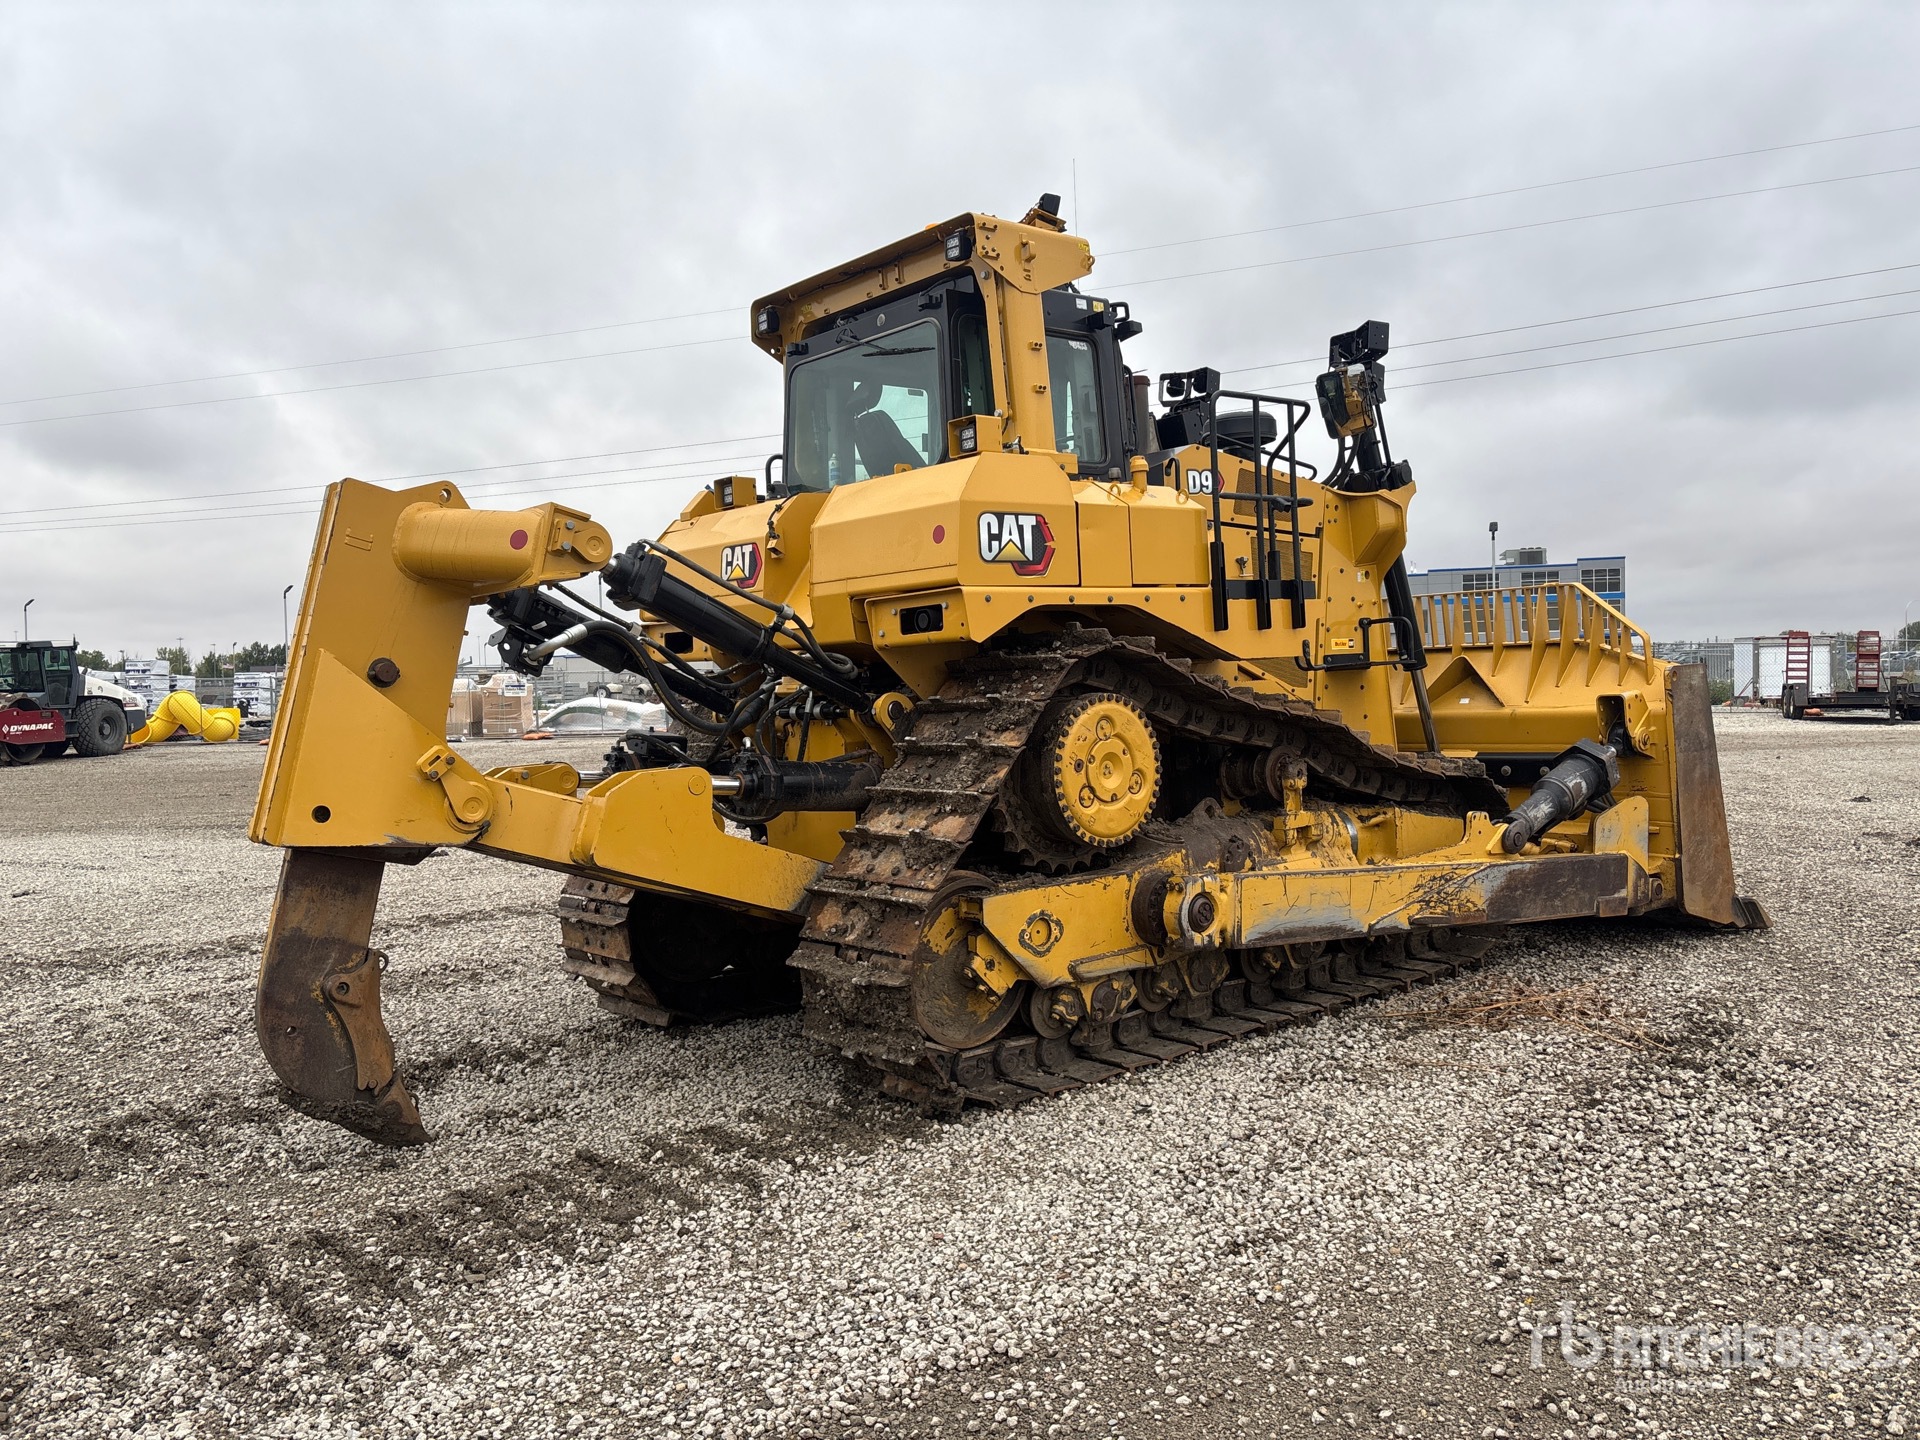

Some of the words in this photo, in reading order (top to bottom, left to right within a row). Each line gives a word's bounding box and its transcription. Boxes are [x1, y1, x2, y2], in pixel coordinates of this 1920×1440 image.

[1187, 470, 1213, 494] D9
[979, 512, 1037, 561] CAT
[721, 543, 753, 581] CAT
[9, 722, 54, 732] DYNAPAC
